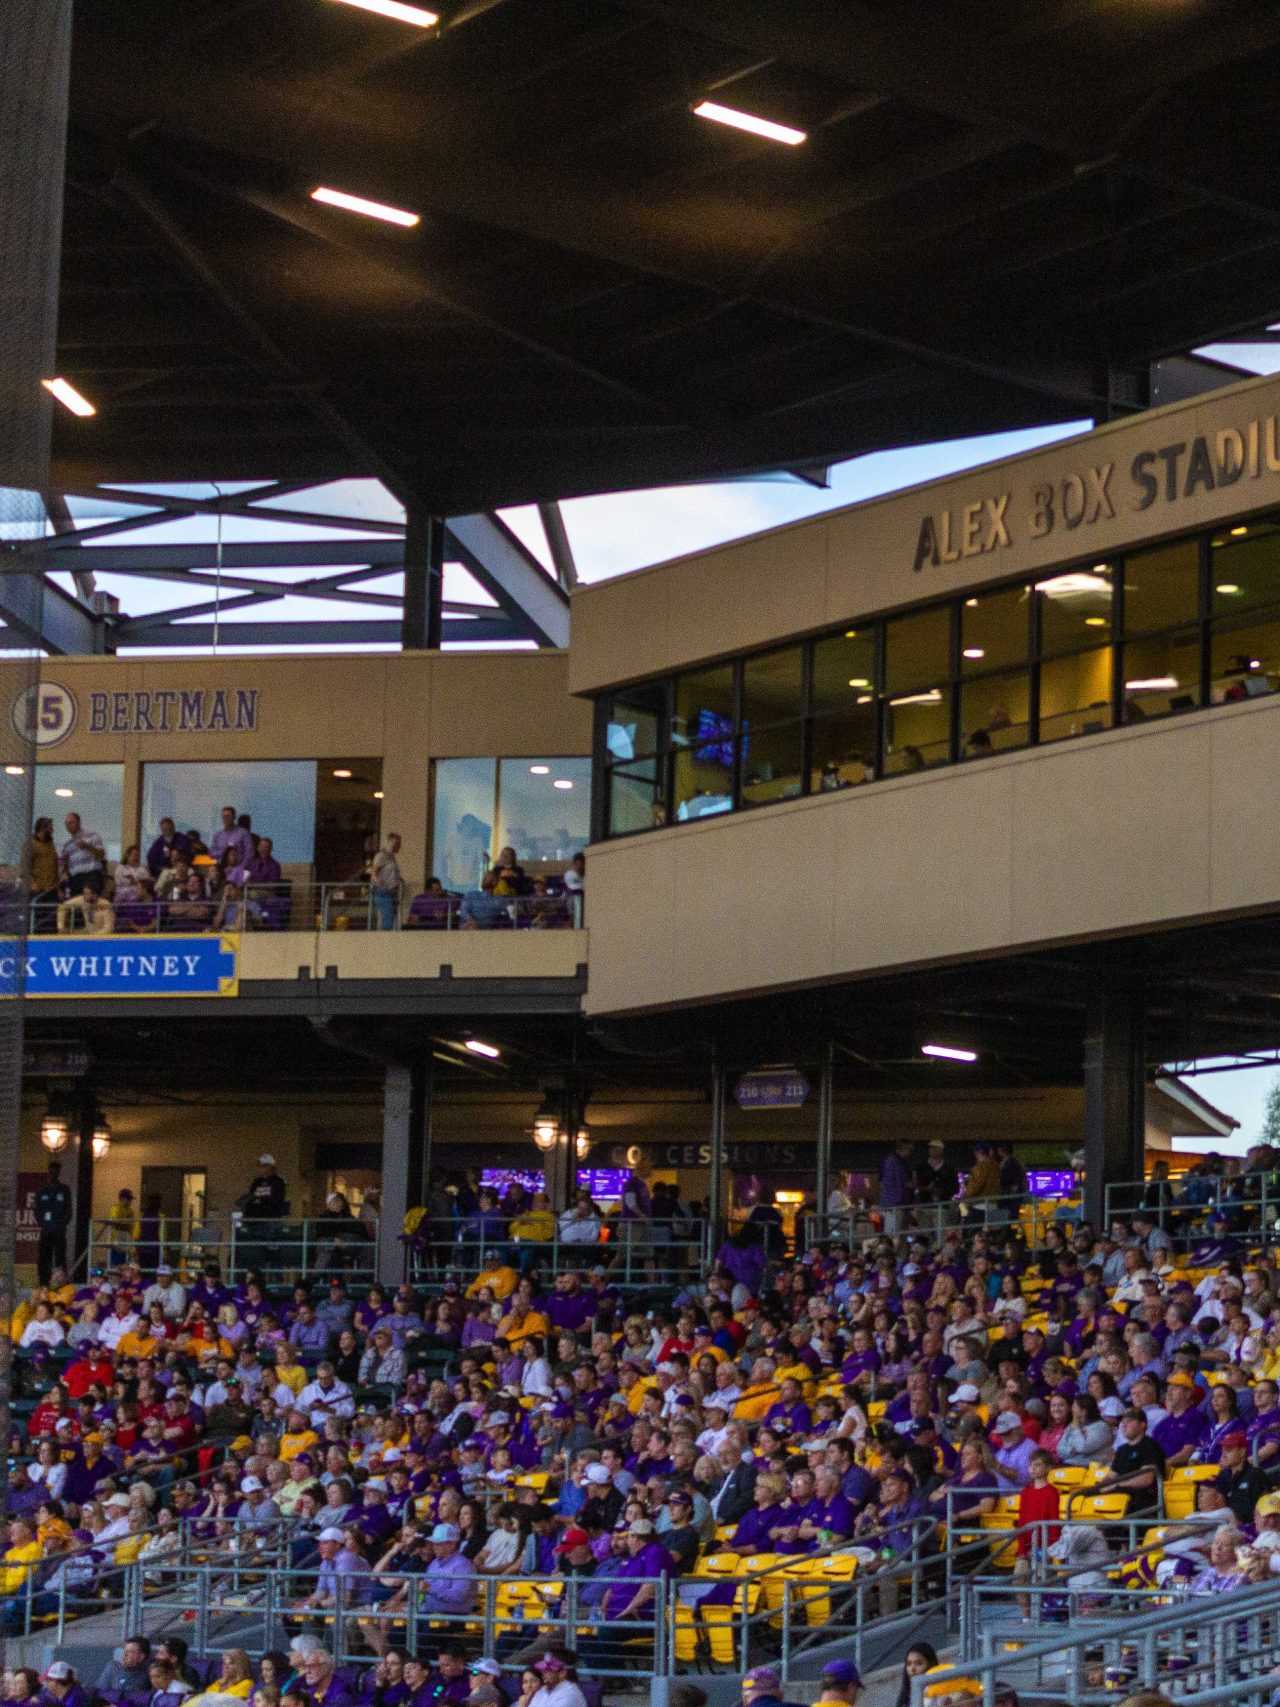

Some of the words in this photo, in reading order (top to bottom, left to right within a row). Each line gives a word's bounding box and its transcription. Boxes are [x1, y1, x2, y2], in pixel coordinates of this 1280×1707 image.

[911, 494, 1013, 572] ALEX
[1028, 462, 1117, 540] BOX
[25, 696, 64, 730] 15
[88, 688, 259, 733] BERTMAN
[49, 955, 202, 977] WHITNEY
[739, 1087, 759, 1098] 210
